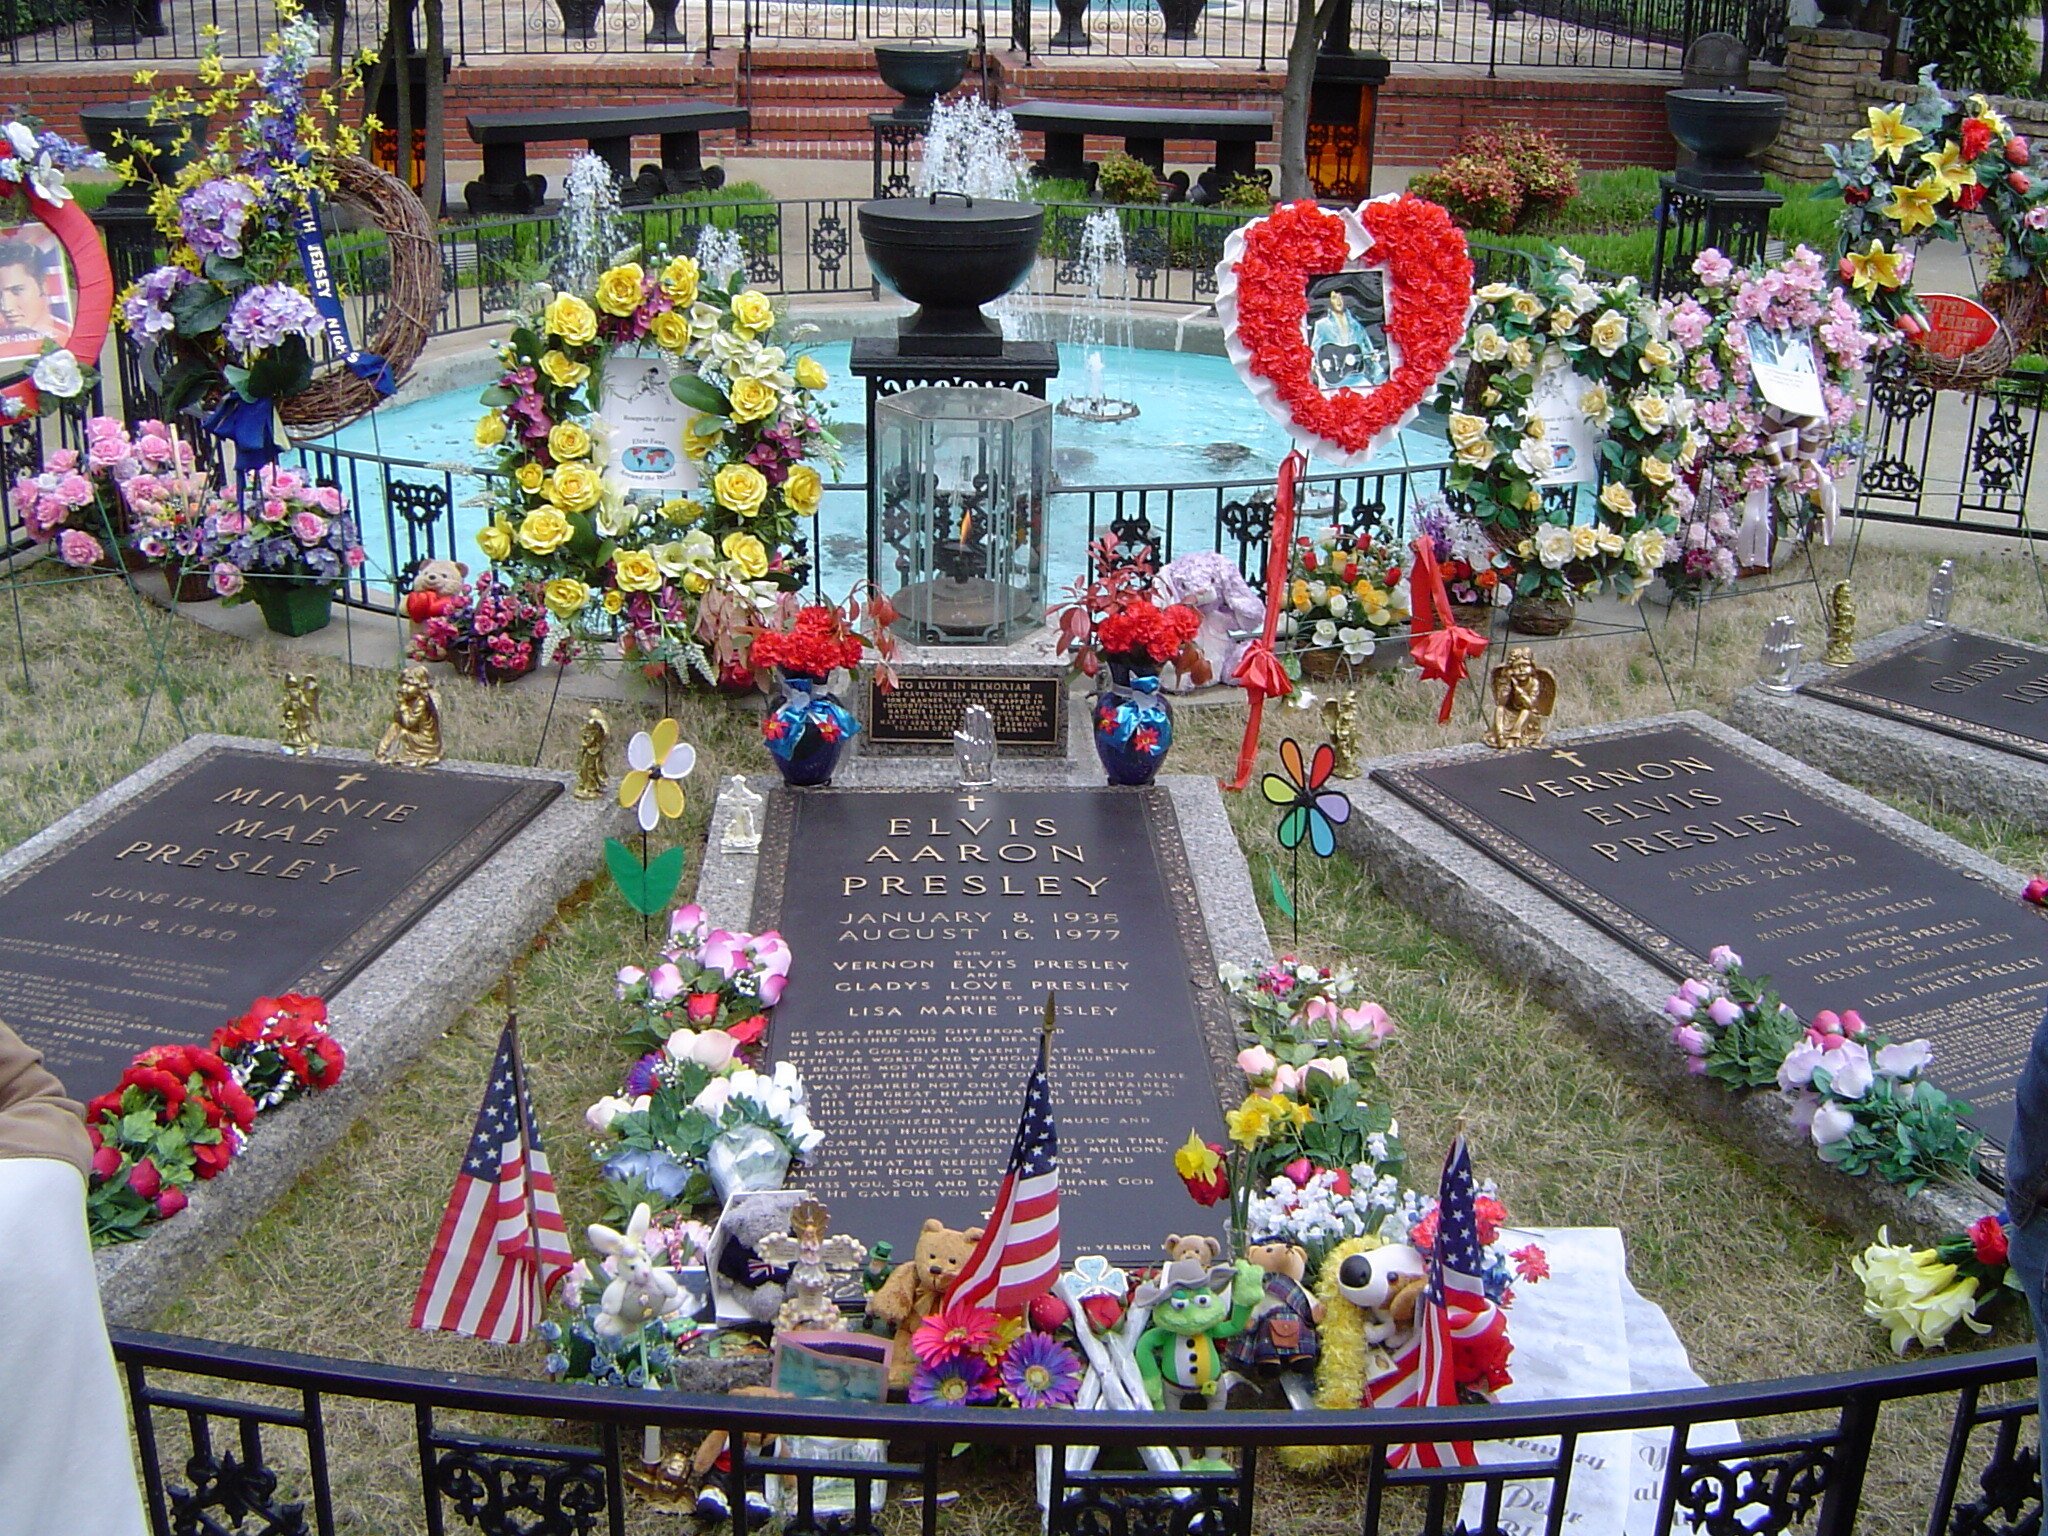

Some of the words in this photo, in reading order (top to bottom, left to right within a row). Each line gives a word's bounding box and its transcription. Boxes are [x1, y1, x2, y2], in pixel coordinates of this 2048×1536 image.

[307, 243, 332, 298] JERSEY
[650, 437, 666, 445] Fans
[621, 470, 642, 480] Around
[657, 471, 677, 480] World
[1931, 653, 2029, 693] GLADYS
[918, 681, 947, 689] ELVIS
[971, 682, 1031, 690] MEMORIAM
[1499, 756, 1715, 803] VERNON
[212, 787, 419, 822] MINNIE
[1583, 788, 1722, 826] ELVIS
[216, 818, 338, 845] MAE
[888, 817, 1059, 837] ELVIS
[1591, 809, 1802, 862] PRESLEY
[114, 841, 361, 884] PRESLEY
[866, 844, 1086, 864] AARON
[1667, 859, 1739, 882] APRIL
[1777, 841, 1830, 859] 1916
[1690, 873, 1756, 896] JUNE
[1801, 854, 1856, 872] 1979
[842, 875, 1110, 897] PRESLEY
[1822, 886, 1891, 904] PRESLEY
[92, 886, 170, 905] JUNE
[208, 900, 277, 918] 1890
[64, 910, 133, 927] MAY
[166, 922, 238, 942] 1980
[839, 912, 992, 925] JANUARY
[1052, 912, 1120, 924] 1935
[1756, 922, 1822, 941] MINNIE
[1866, 897, 1936, 917] PRESLEY
[838, 928, 980, 942] AUGUST
[1054, 929, 1120, 941] 1977
[1788, 949, 1840, 966] ELVIS
[1846, 934, 1909, 954] AARON
[1910, 918, 1980, 939] PRESLEY
[832, 960, 934, 971] VERNON
[953, 960, 1017, 970] ELVIS
[1034, 960, 1130, 970] PRESLEY
[1814, 965, 1870, 984] JESSIE
[1943, 932, 2013, 954] PRESLEY
[835, 981, 931, 992] GLADYS
[950, 981, 1012, 991] LOVE
[1031, 981, 1130, 991] PRESLEY
[1864, 990, 1908, 1007] LISA
[1910, 974, 1971, 996] MARIE
[1970, 956, 2043, 980] PRESLEY
[849, 1006, 902, 1017] LISA
[919, 1006, 998, 1016] MARIE
[867, 1028, 938, 1036] PRECIOUS
[820, 1100, 845, 1108] HIS
[957, 1098, 988, 1106] AND
[998, 1098, 1022, 1106] HIS
[847, 1091, 874, 1099] THE
[855, 1108, 912, 1116] FELLOW
[900, 1127, 966, 1135] HIGHEST
[971, 1147, 1002, 1155] AND
[824, 1160, 854, 1168] SAW
[1101, 1157, 1134, 1165] AND
[893, 1179, 925, 1187] SON
[1118, 1177, 1154, 1186] GOD
[827, 1190, 849, 1198] HE
[858, 1190, 901, 1198] GAVE
[939, 1189, 970, 1197] YOU
